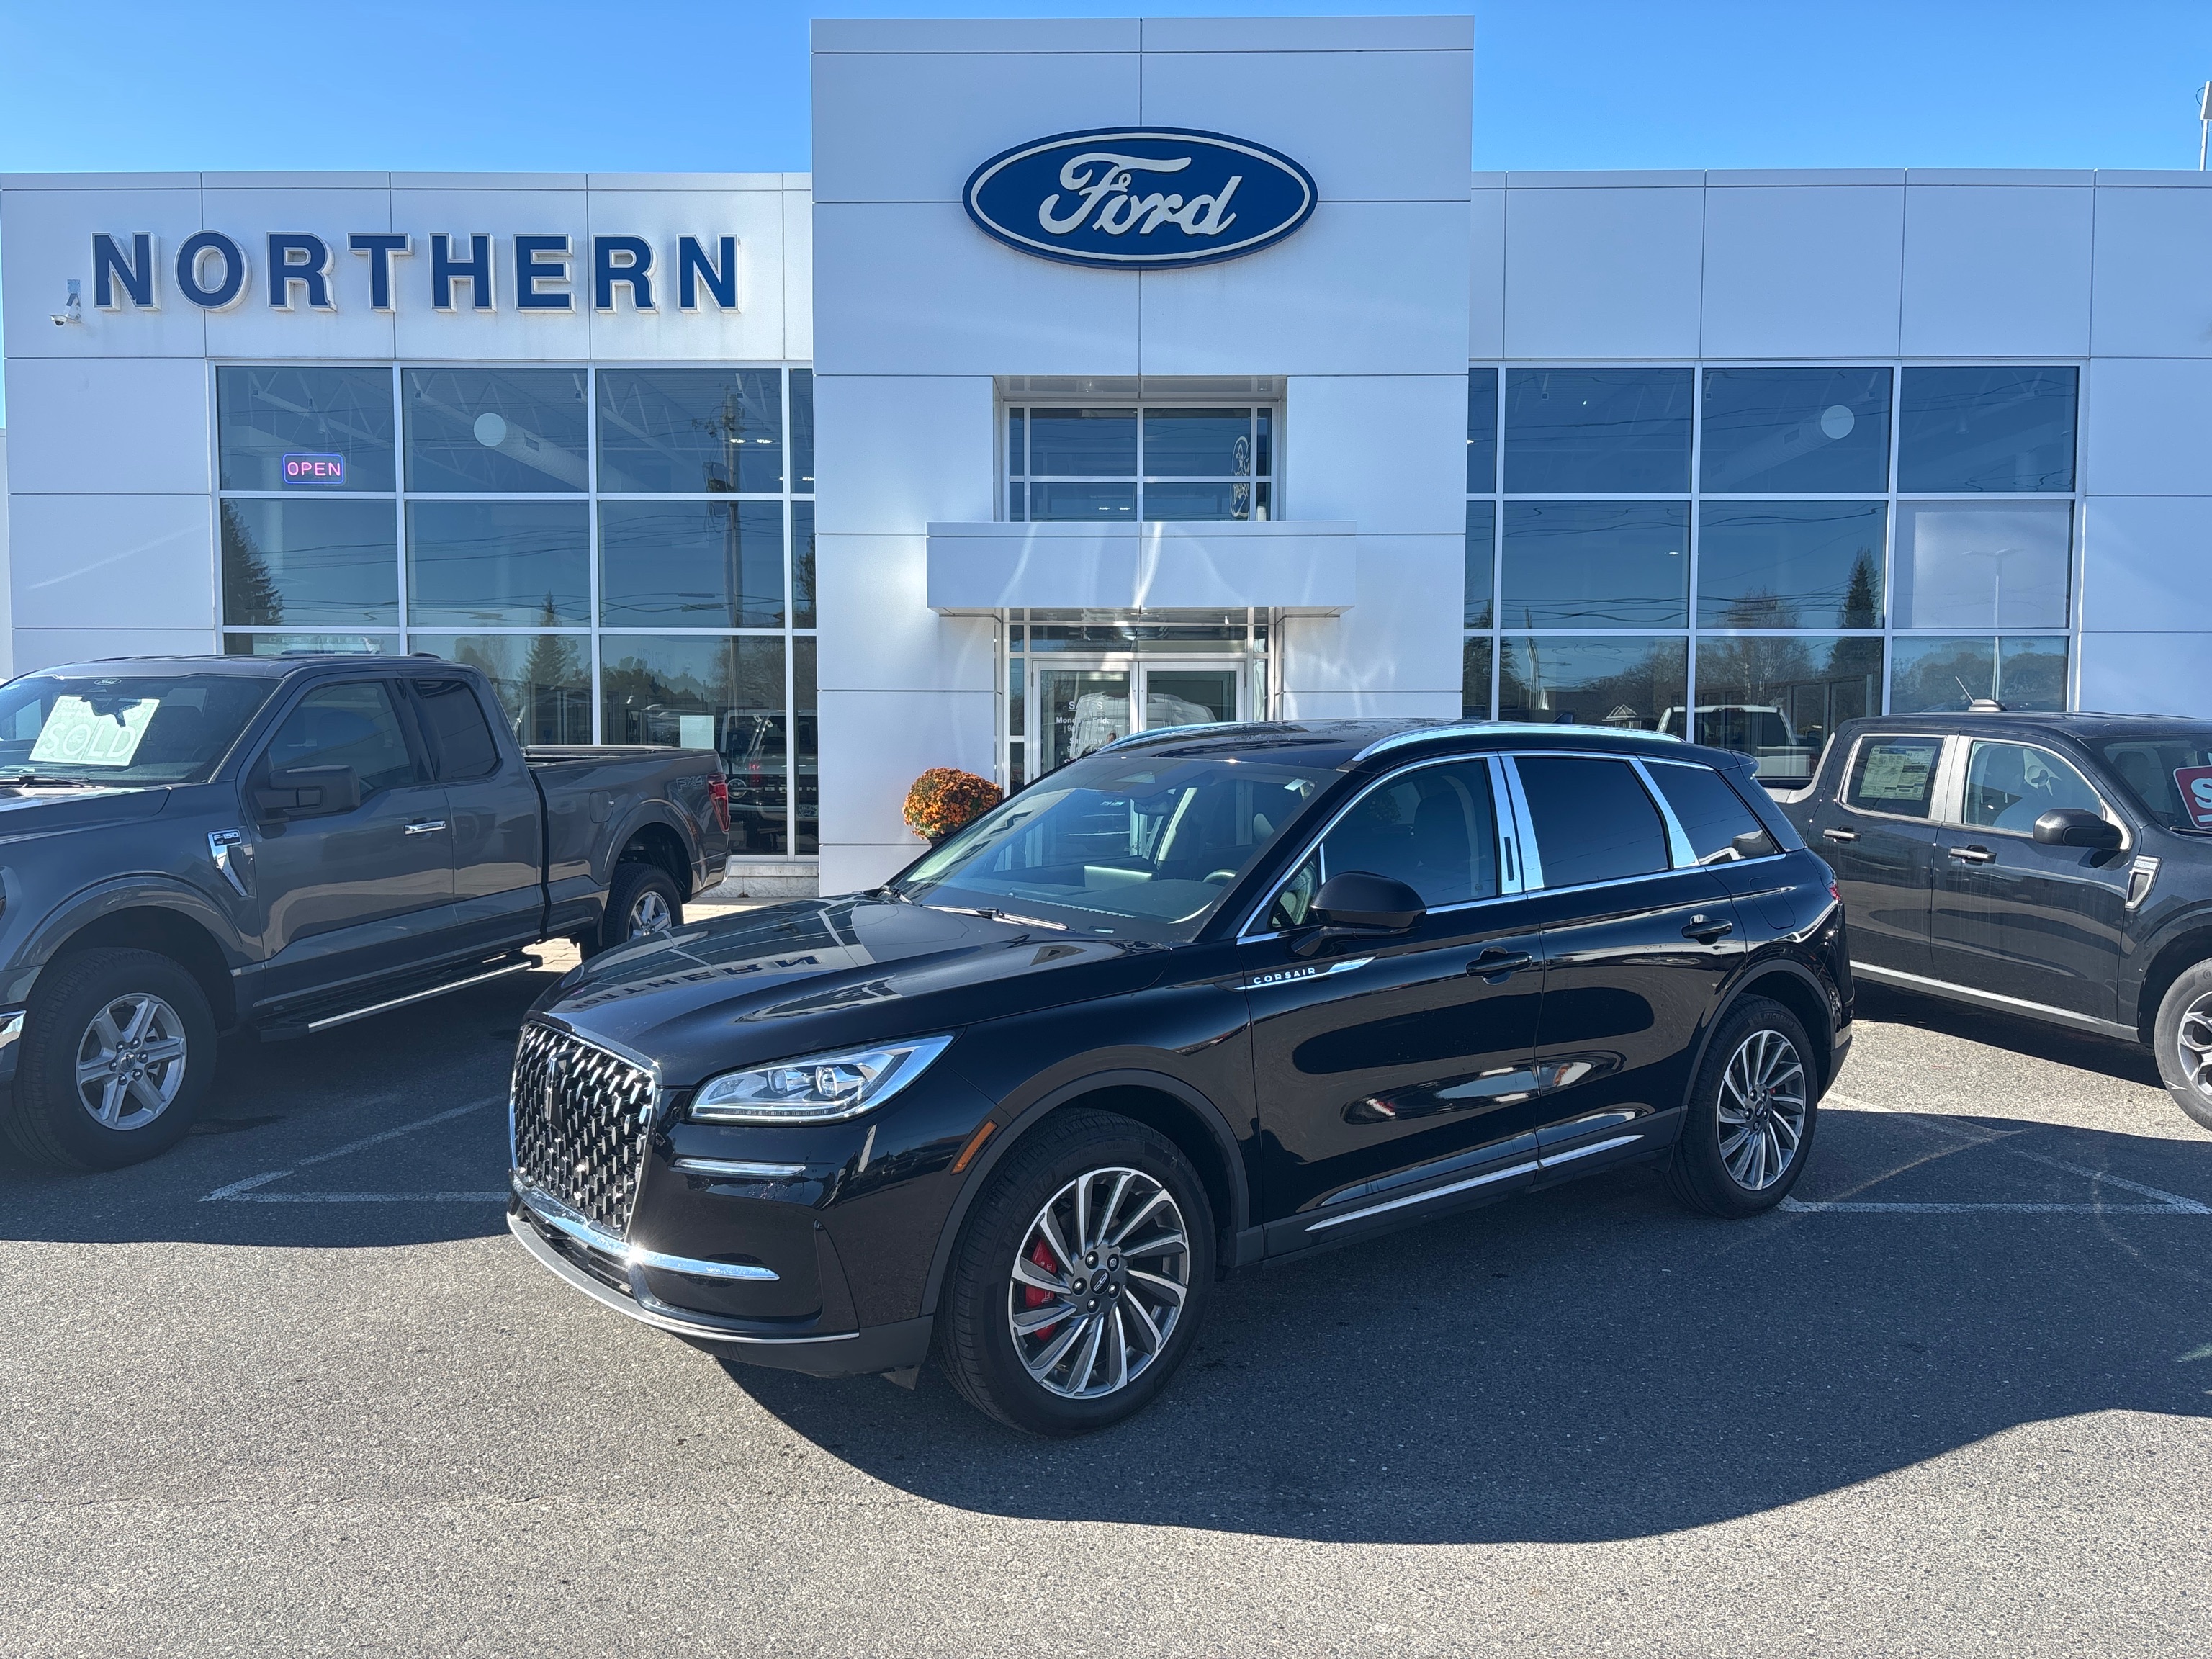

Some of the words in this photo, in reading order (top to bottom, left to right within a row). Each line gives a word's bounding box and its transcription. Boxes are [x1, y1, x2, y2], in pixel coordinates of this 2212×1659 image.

[1038, 153, 1243, 235] Ford
[91, 230, 741, 313] NORTHERN
[287, 462, 341, 476] OPEN
[40, 723, 137, 757] SOLD
[676, 775, 704, 792] FX4
[1253, 967, 1316, 984] CORSAIR
